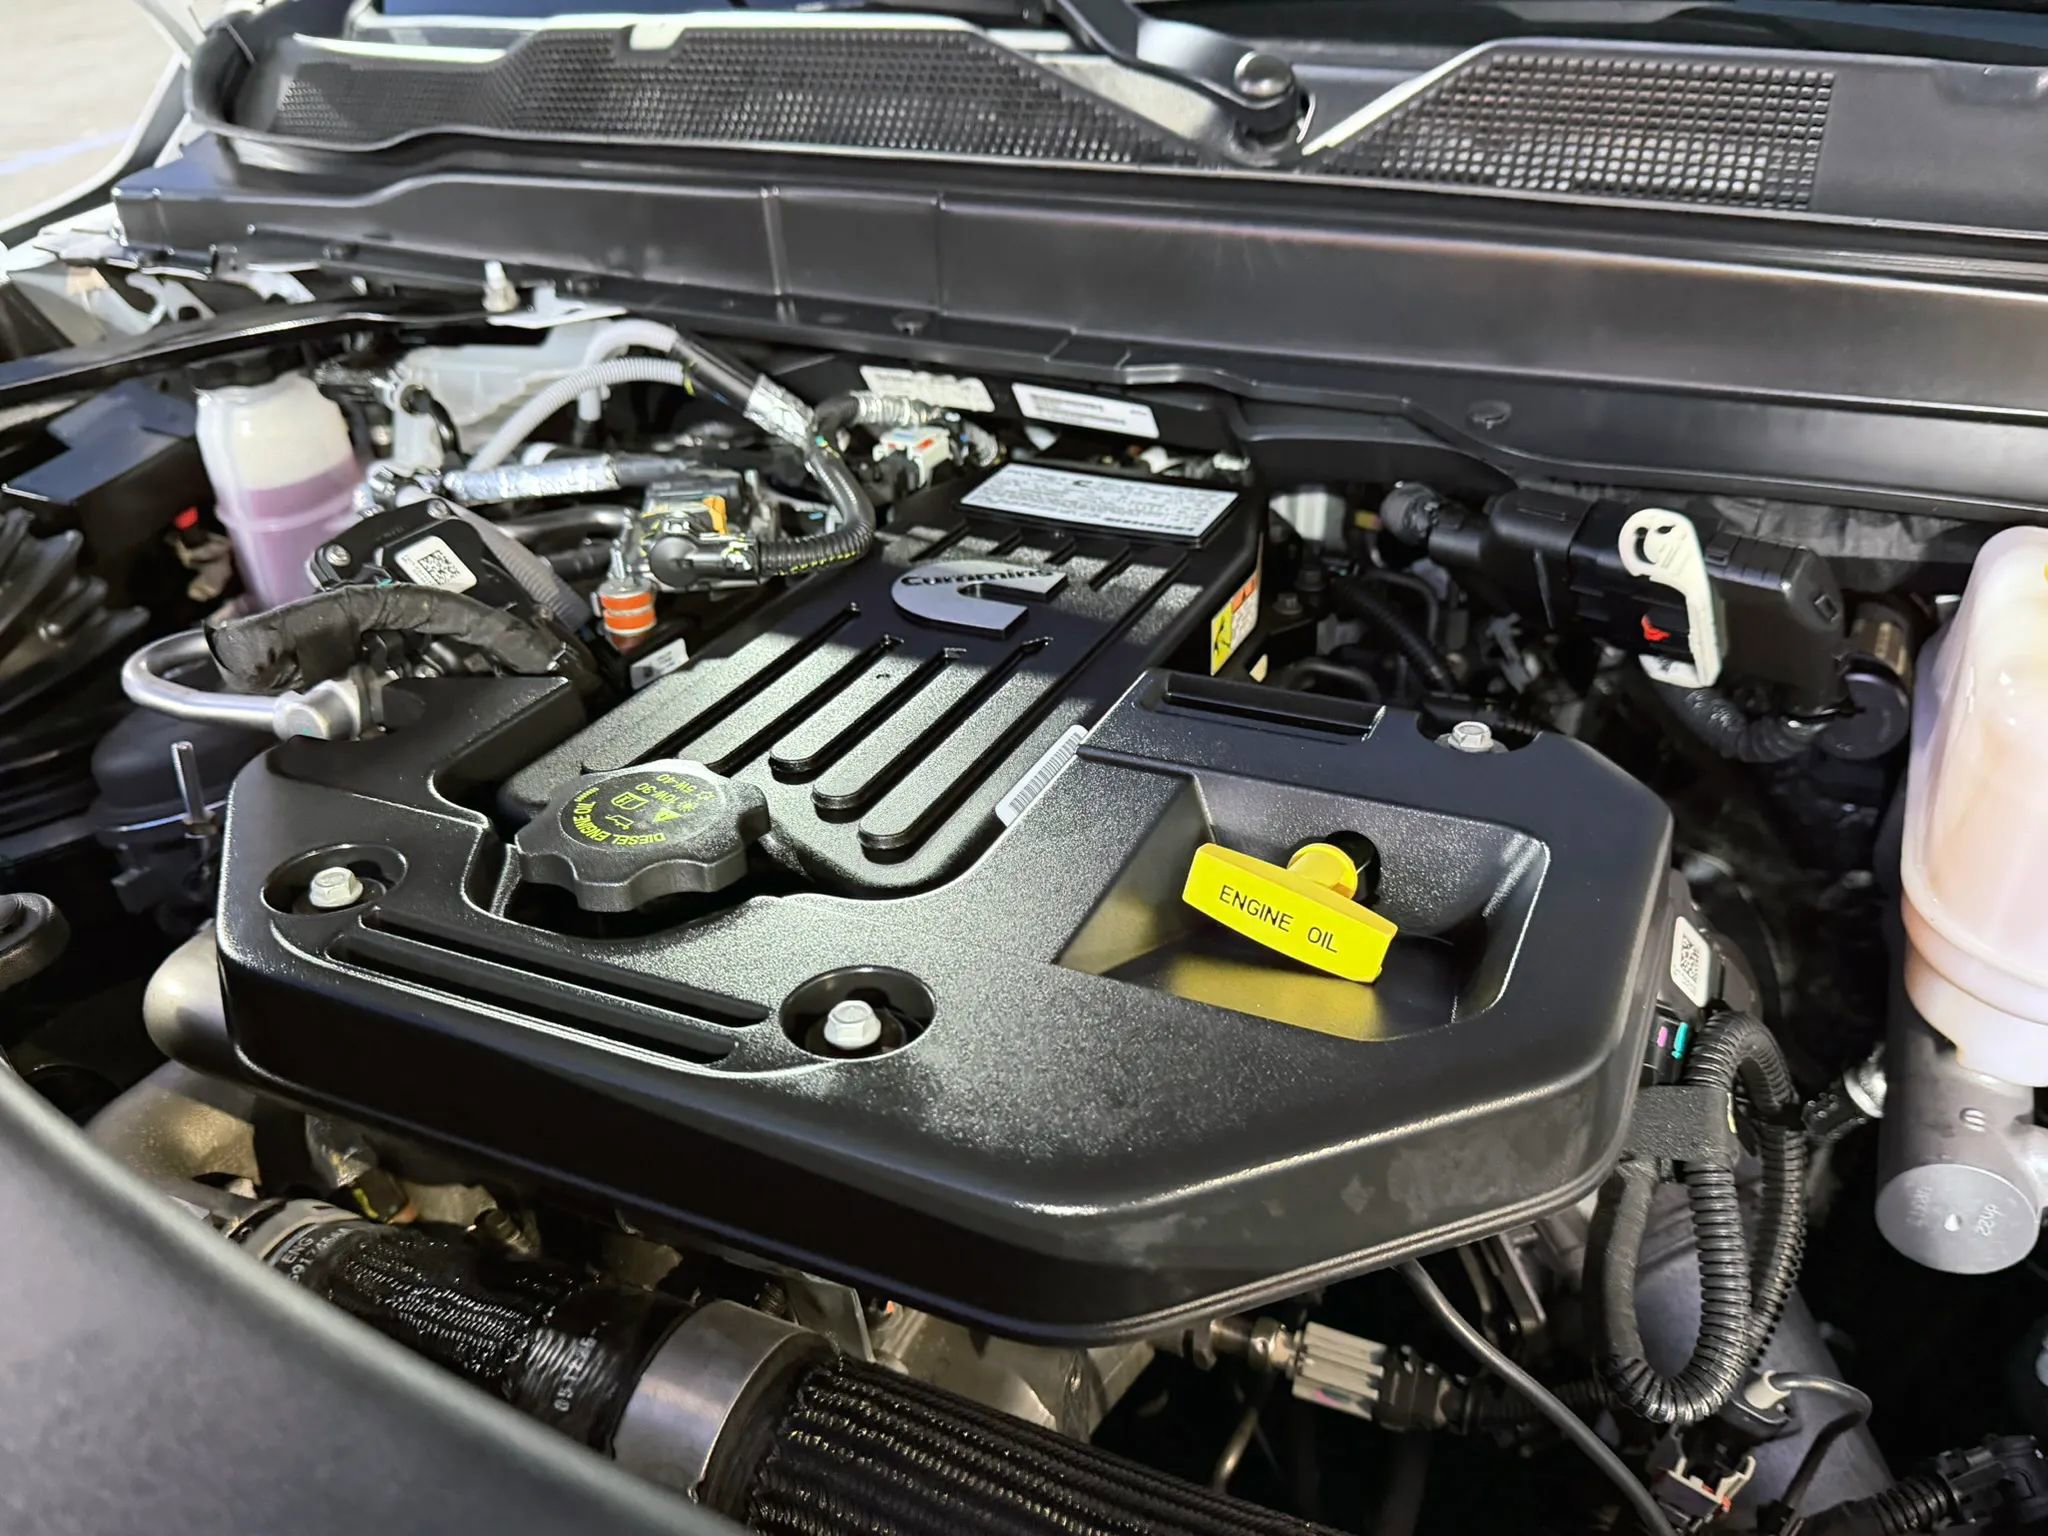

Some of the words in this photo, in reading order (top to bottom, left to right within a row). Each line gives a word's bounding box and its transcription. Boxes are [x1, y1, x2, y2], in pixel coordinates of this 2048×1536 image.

[900, 569, 1053, 586] Cummins
[573, 801, 597, 815] OIL
[573, 815, 611, 842] ENGINE
[612, 832, 666, 845] DIESEL
[1219, 884, 1294, 932] ENGINE
[1307, 926, 1339, 954] OIL
[281, 1238, 314, 1264] ENG
